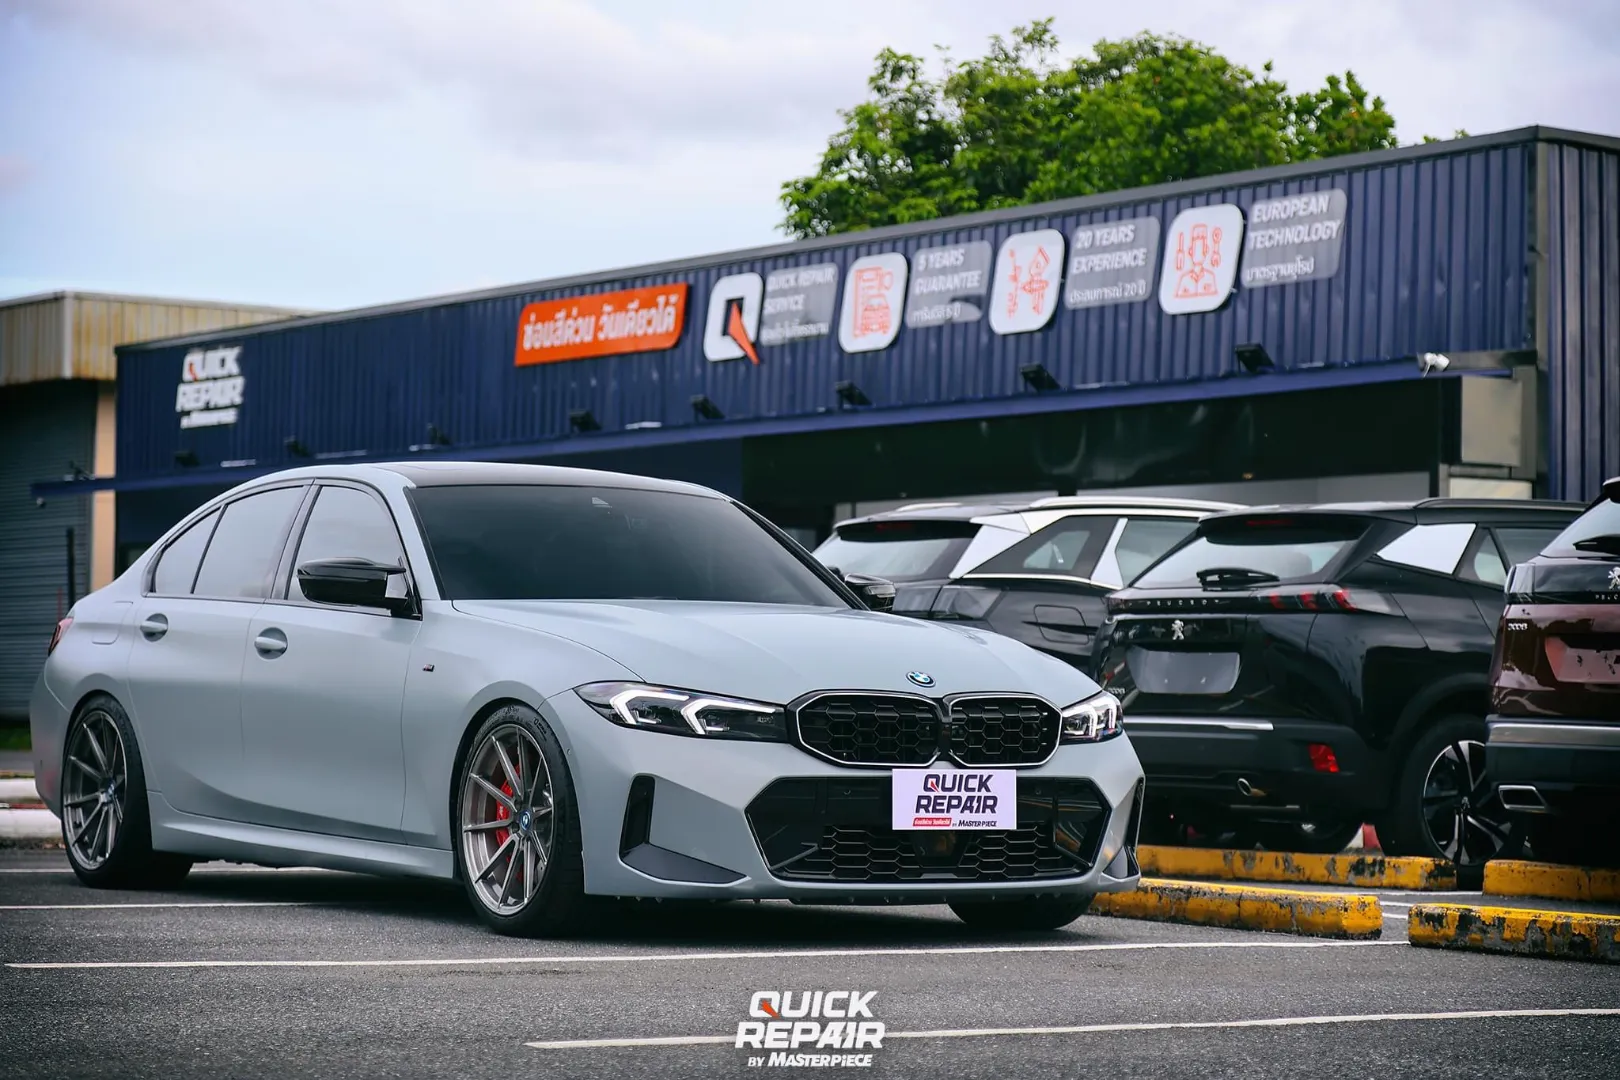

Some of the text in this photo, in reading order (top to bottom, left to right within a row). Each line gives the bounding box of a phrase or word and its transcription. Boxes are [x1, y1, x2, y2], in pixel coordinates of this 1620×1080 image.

[1252, 194, 1330, 223] EUROPEAN
[1076, 224, 1135, 249] 20 YEARS
[1249, 220, 1341, 250] TECHNOLOGY
[928, 248, 965, 269] YEARS
[1072, 248, 1147, 274] EXPERIENCE
[915, 270, 982, 295] GUARANTEE
[183, 347, 243, 383] QUICK
[175, 376, 245, 412] REPAIR
[923, 774, 994, 793] QUICK
[915, 795, 998, 814] REPAIR
